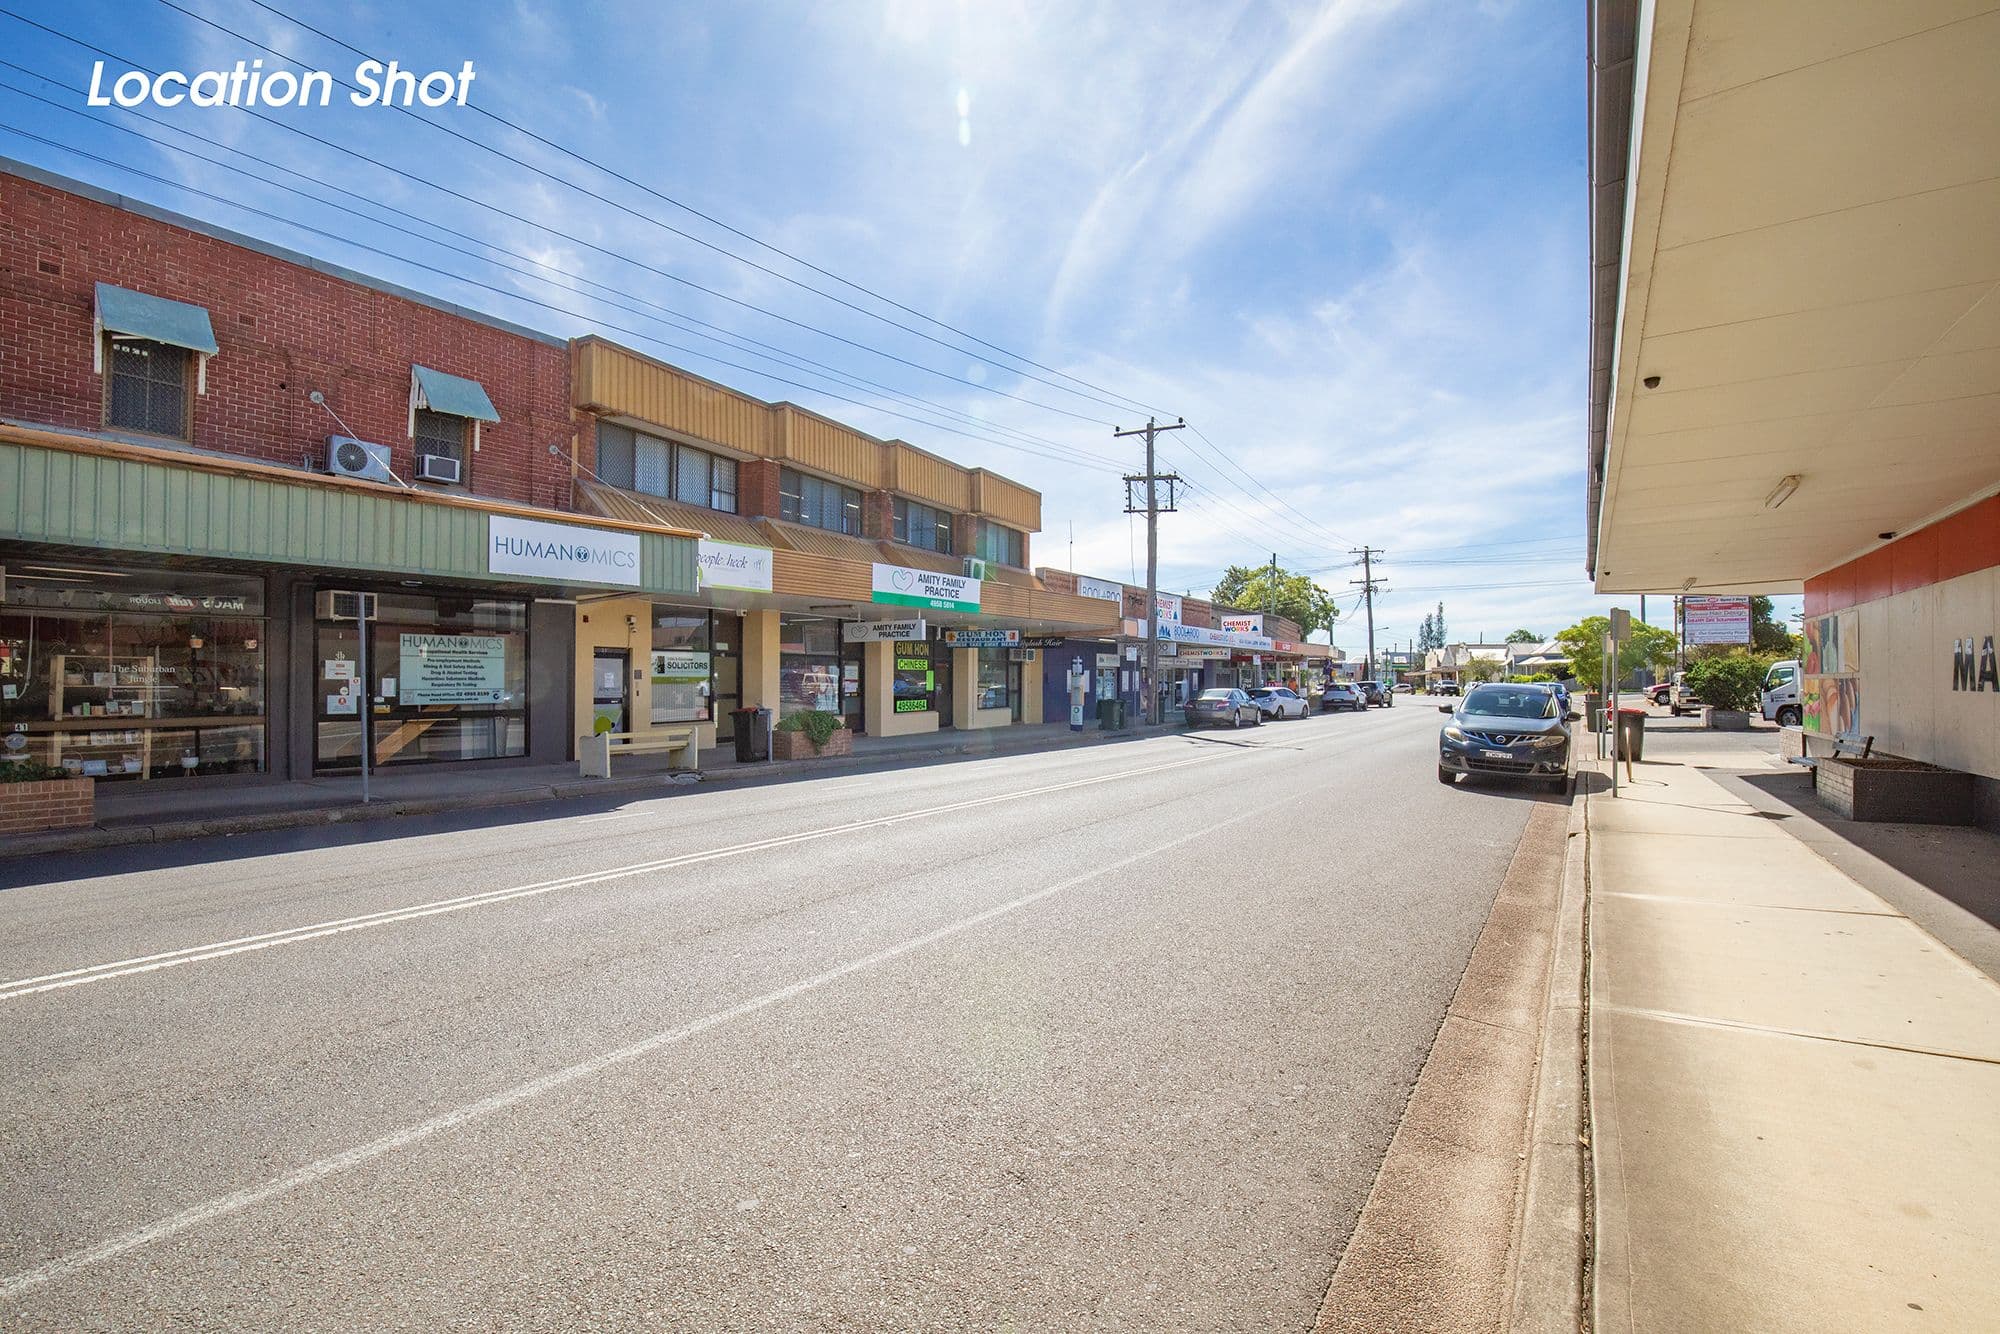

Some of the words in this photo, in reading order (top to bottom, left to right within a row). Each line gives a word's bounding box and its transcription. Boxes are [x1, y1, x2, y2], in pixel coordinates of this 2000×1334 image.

[495, 536, 635, 569] HUMANOMICS
[918, 573, 941, 586] AMITY
[942, 577, 967, 589] FAMILY
[925, 585, 960, 599] PRACTICE
[878, 630, 911, 638] PRACTICE
[402, 635, 503, 650] HUMANOMICS
[896, 642, 913, 656] GUM
[913, 643, 930, 657] HON
[112, 664, 130, 673] The
[132, 664, 176, 673] Suburban
[667, 662, 708, 670] SOLICITORS
[899, 659, 928, 670] CHINESE
[15, 723, 28, 731] 41
